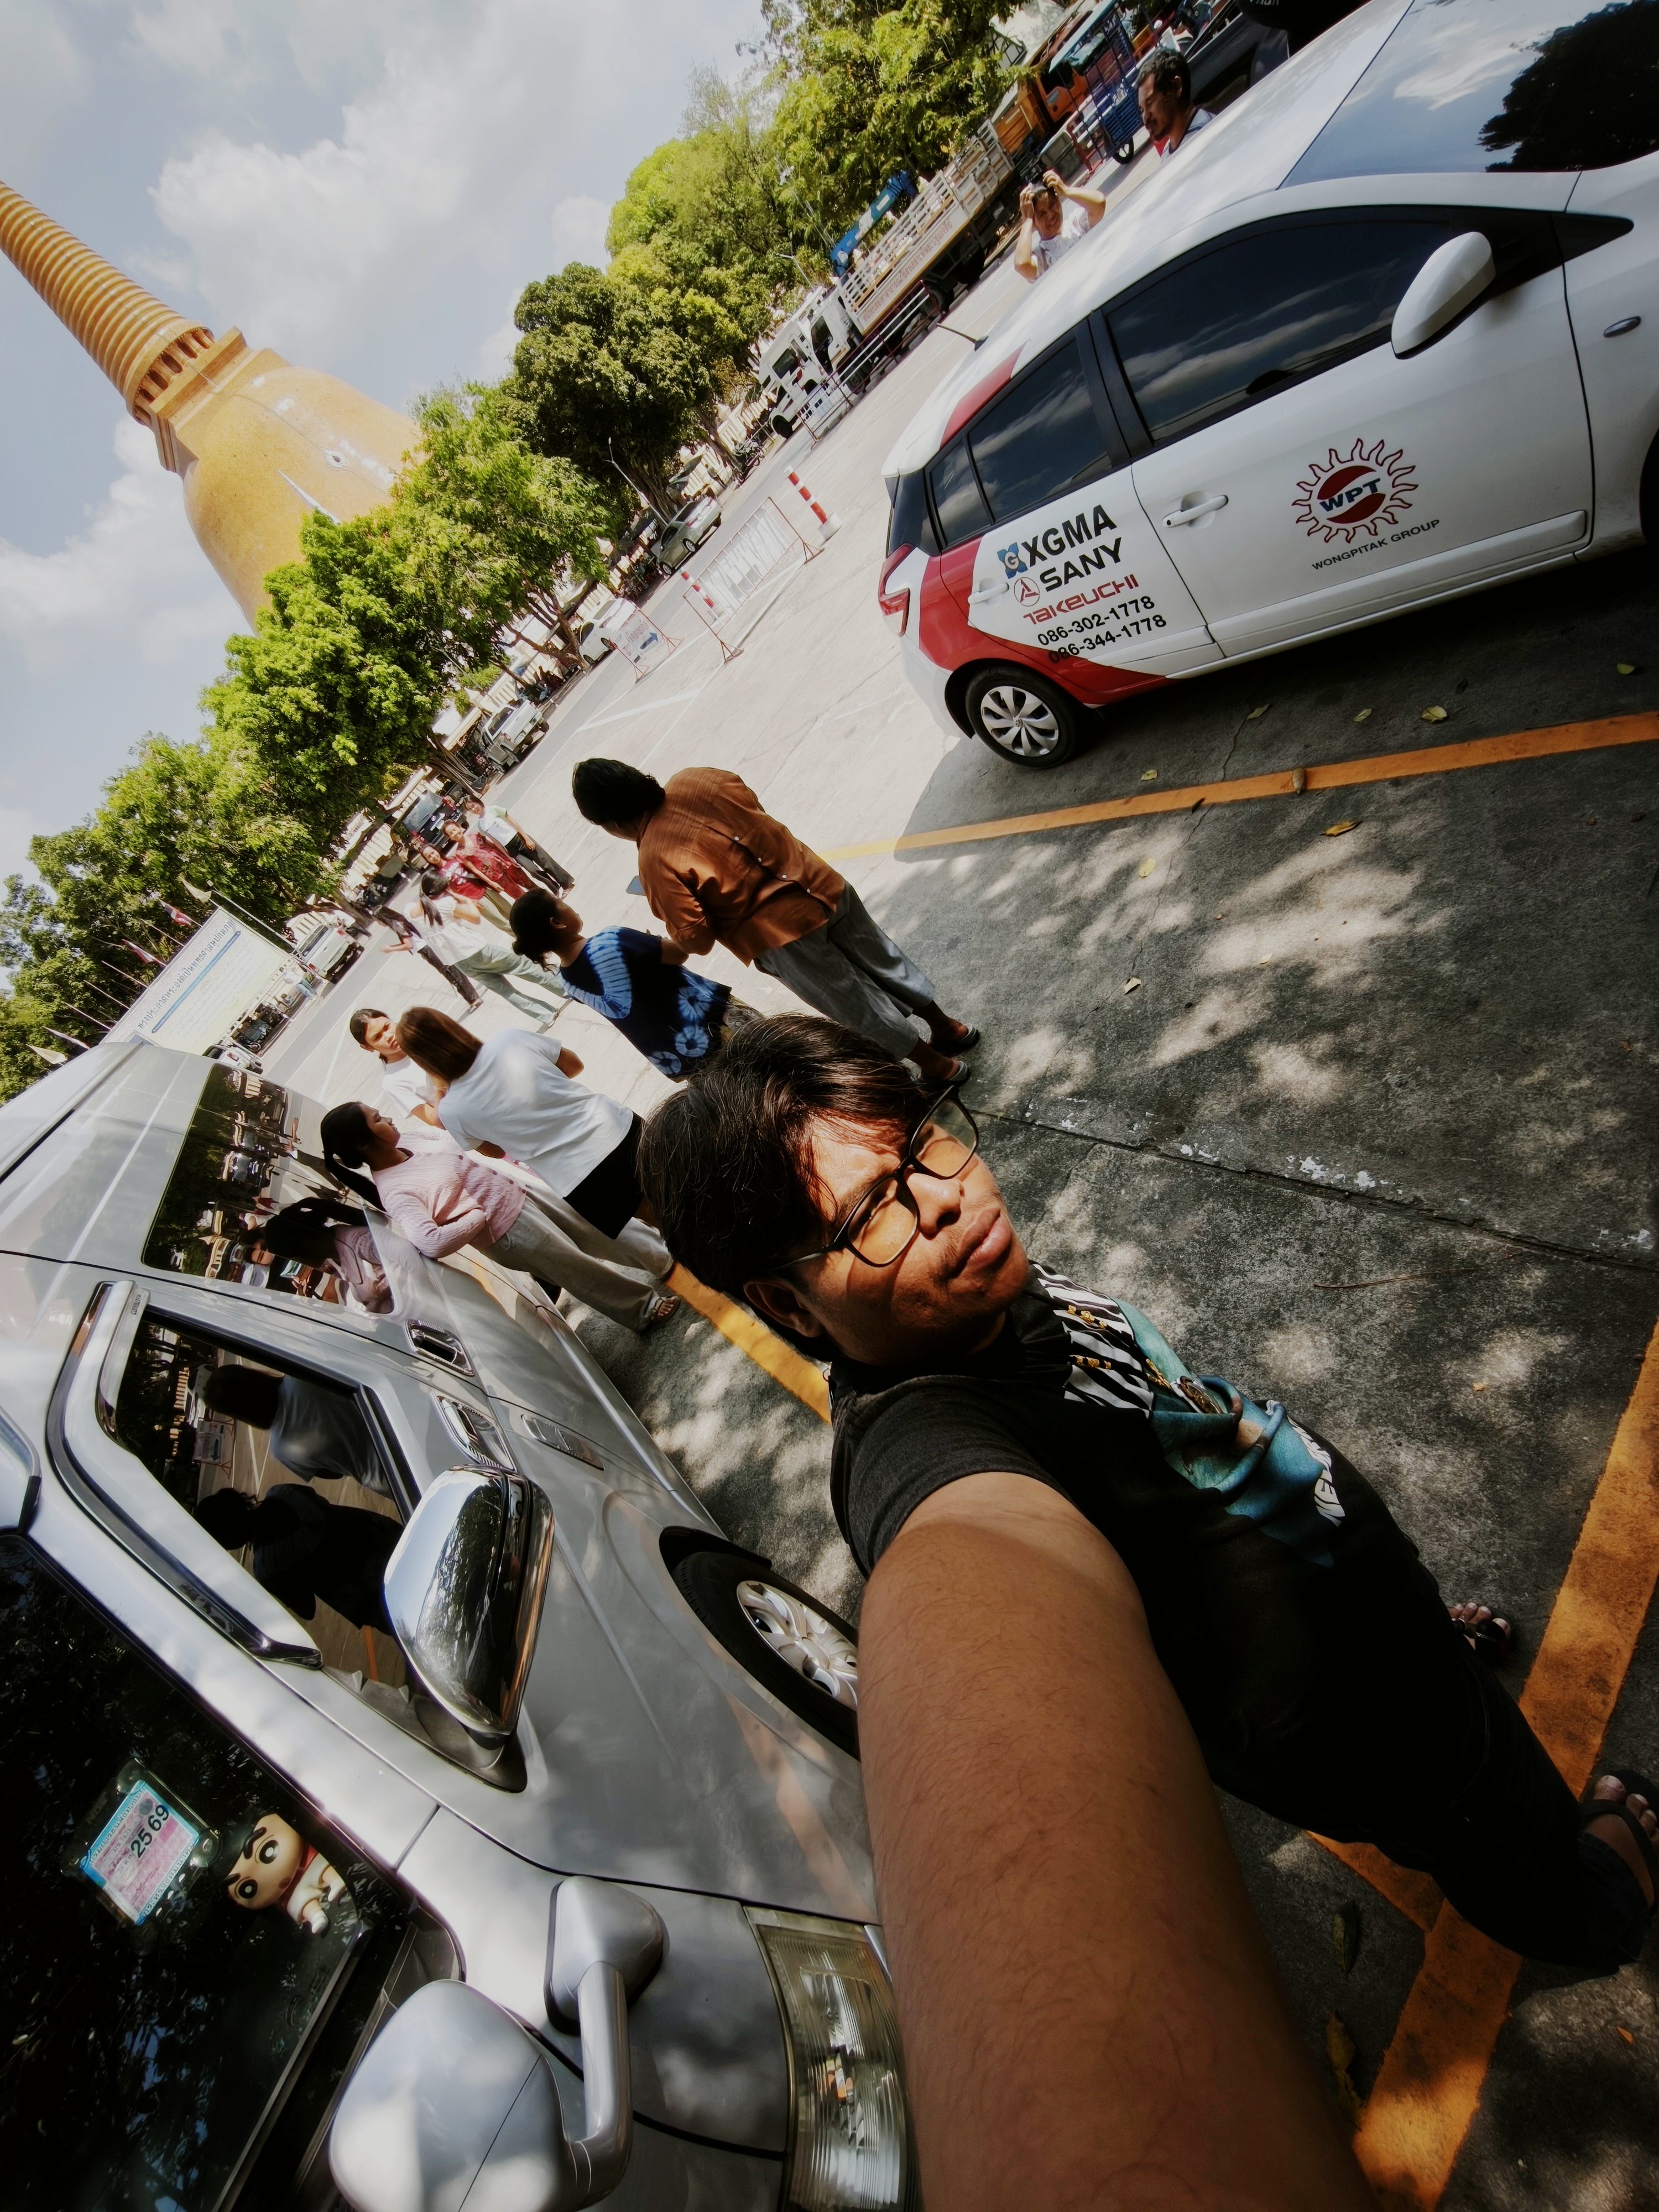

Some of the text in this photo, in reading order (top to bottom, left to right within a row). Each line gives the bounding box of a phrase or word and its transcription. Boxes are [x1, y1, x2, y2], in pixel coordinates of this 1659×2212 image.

[1319, 478, 1381, 512] WPT
[1021, 504, 1117, 567] XGMA
[1311, 519, 1440, 570] WONGPITAK GROUP
[1040, 537, 1121, 592] SANY
[1037, 596, 1155, 646] 086-302-1778
[1048, 614, 1167, 664] 086-344-1778
